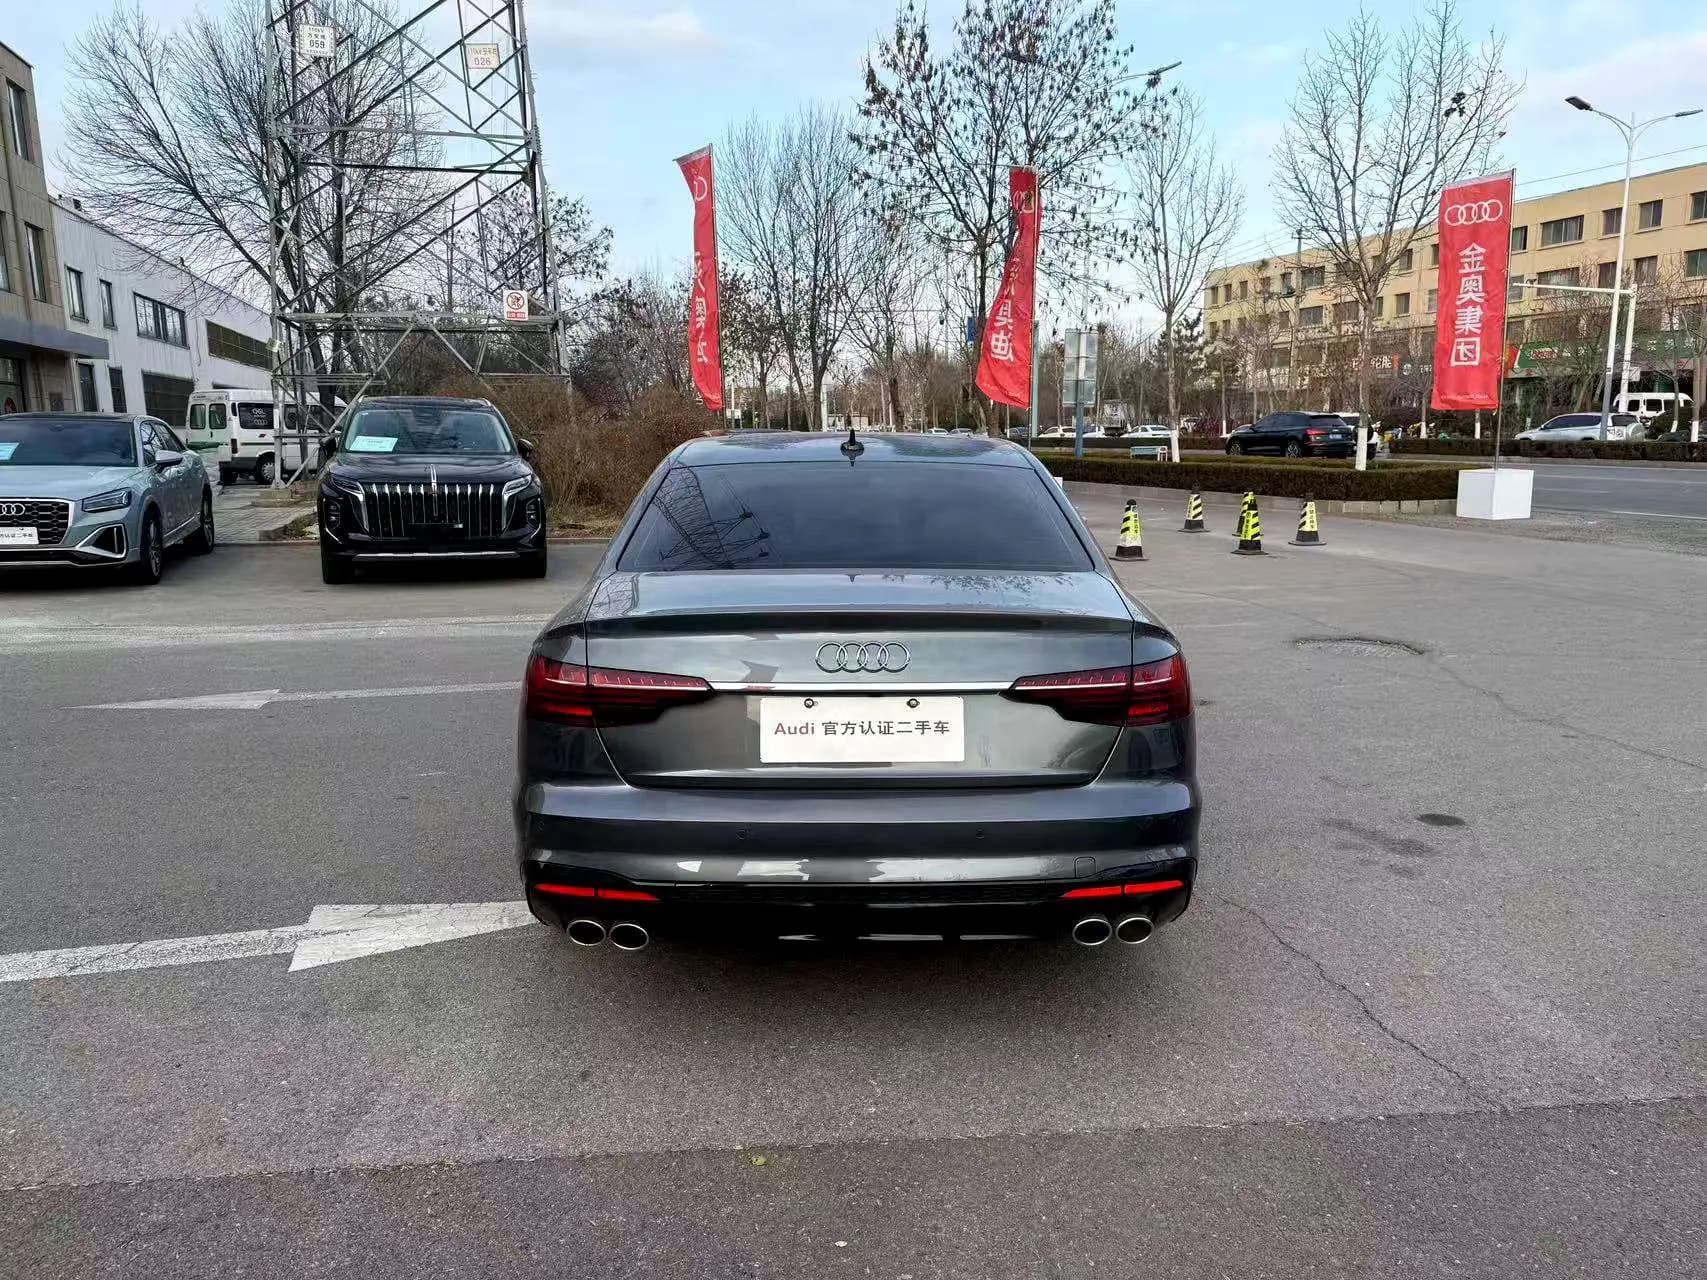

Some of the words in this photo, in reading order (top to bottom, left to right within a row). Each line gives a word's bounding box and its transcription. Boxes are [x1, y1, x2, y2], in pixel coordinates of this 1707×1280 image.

[309, 40, 325, 49] 059
[474, 57, 491, 66] 026
[774, 722, 815, 735] Audi
[822, 721, 950, 735] 官方认证二手车
